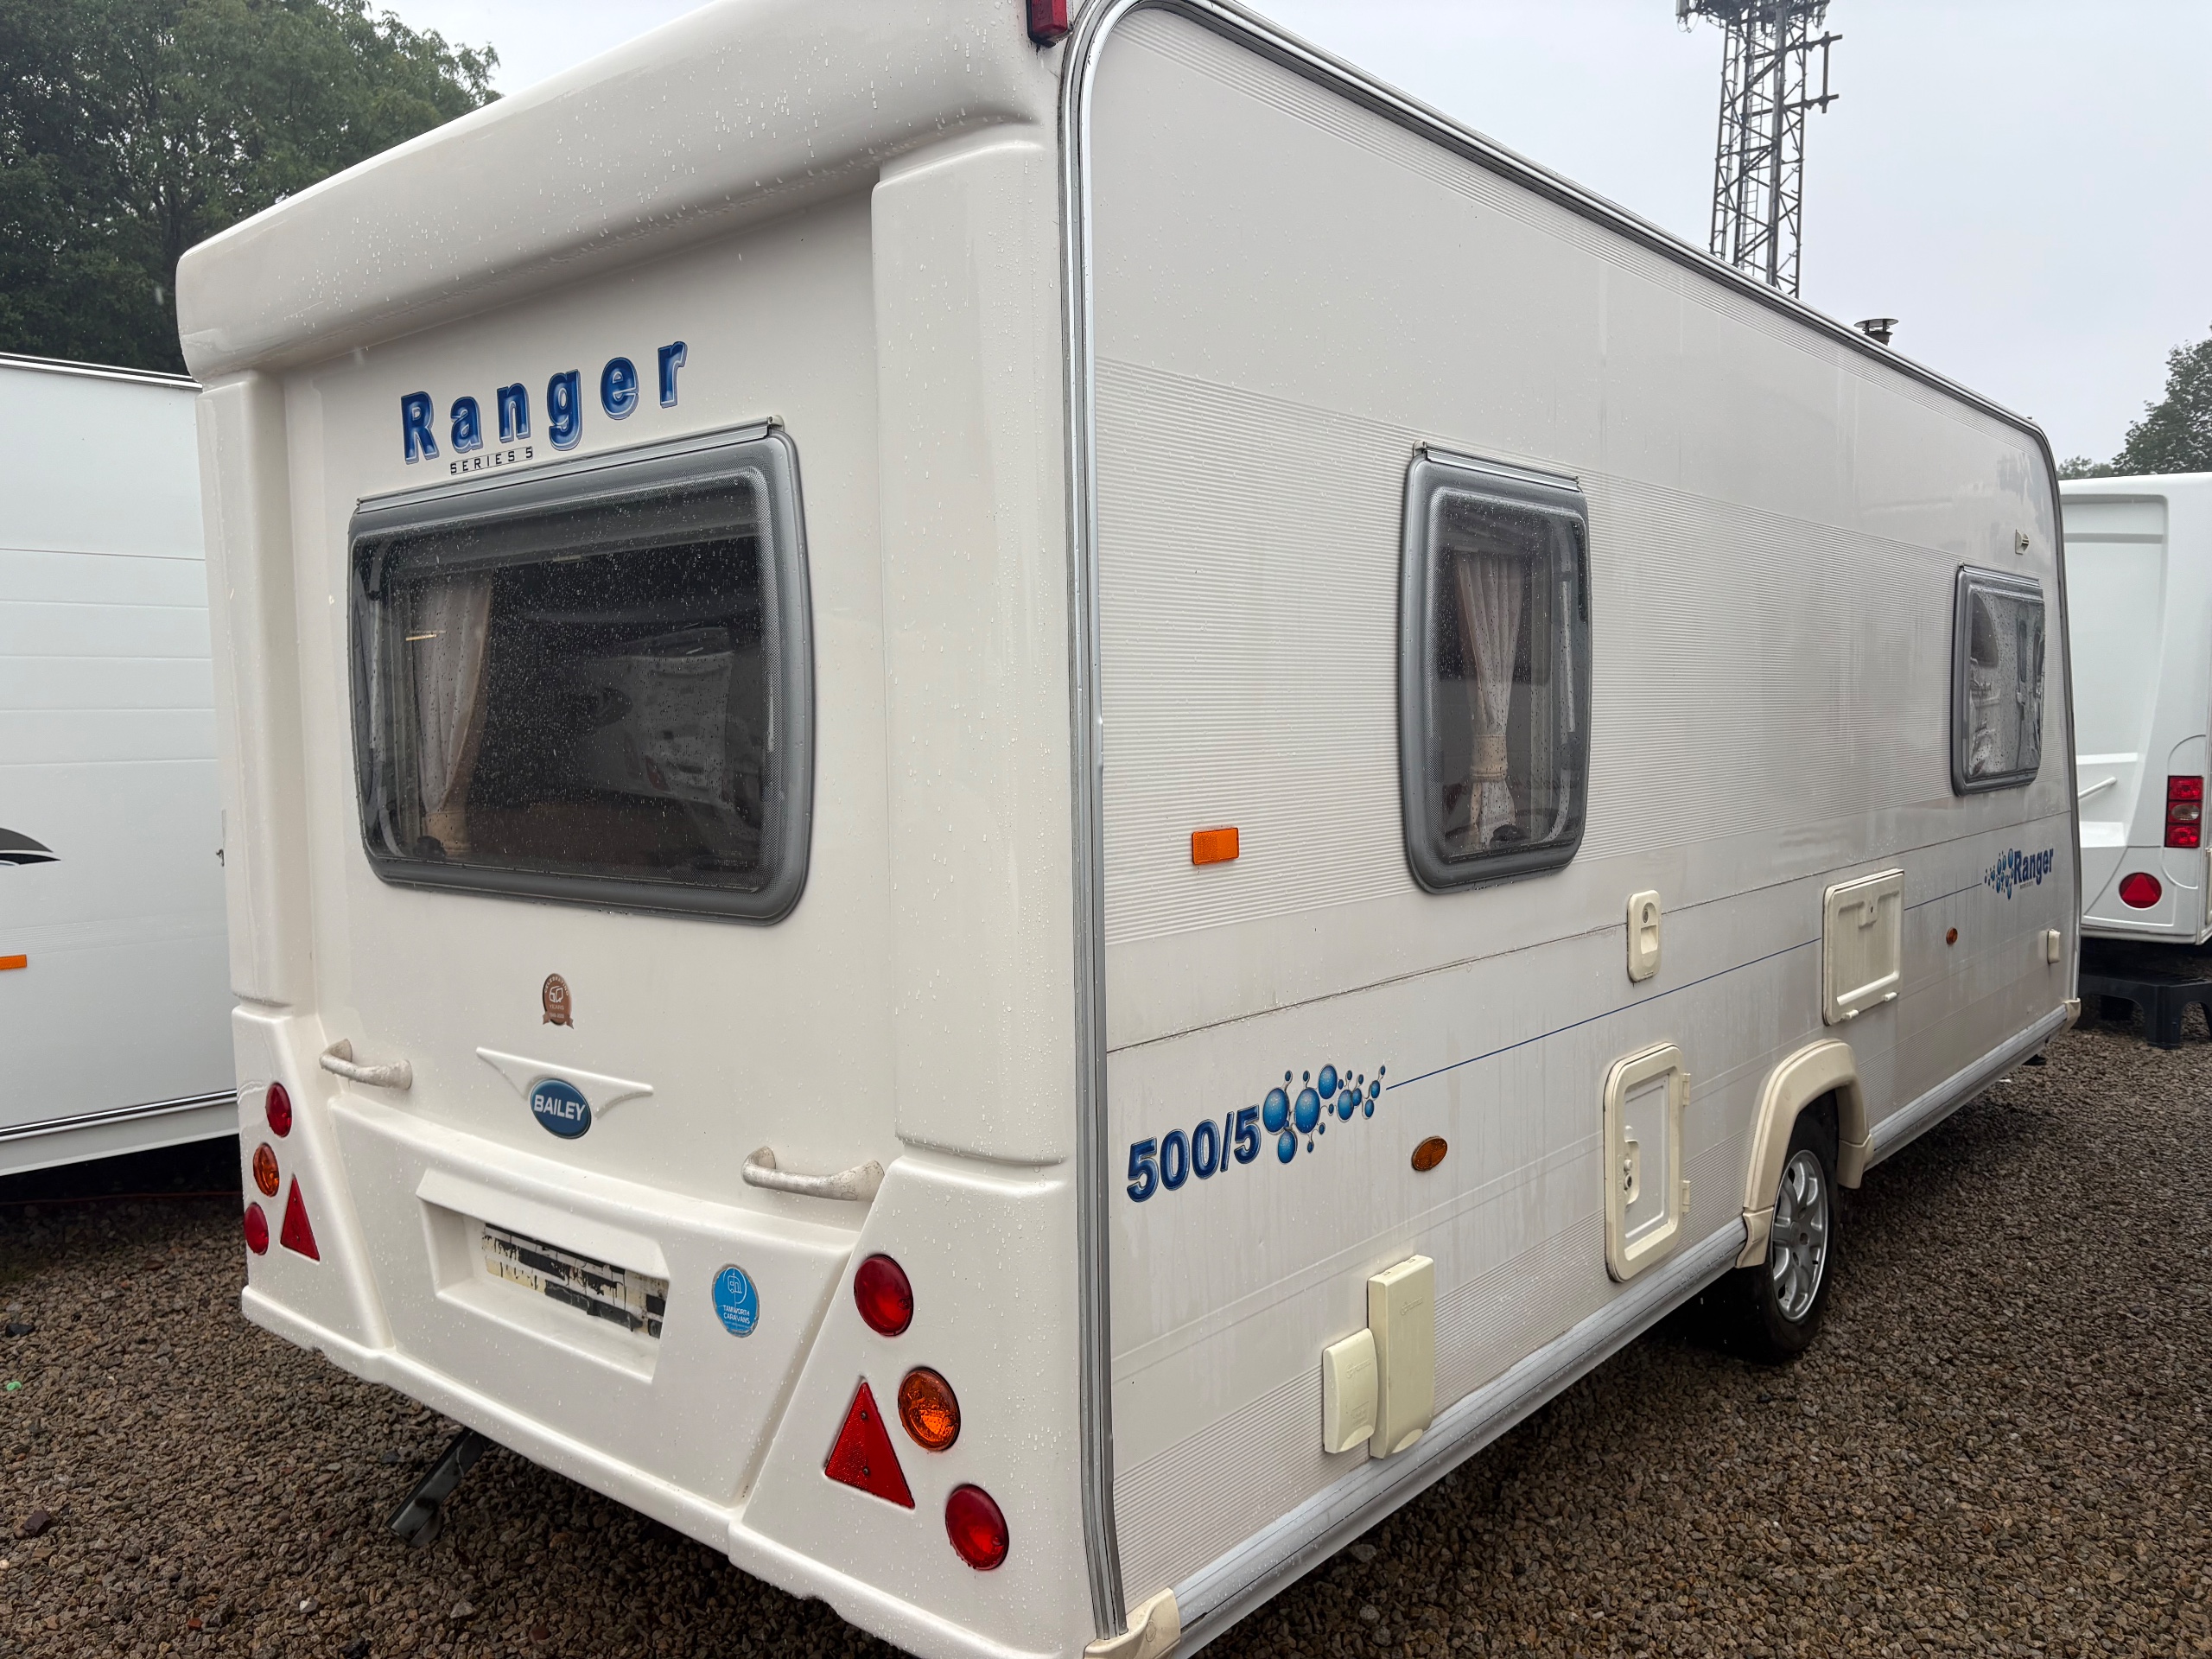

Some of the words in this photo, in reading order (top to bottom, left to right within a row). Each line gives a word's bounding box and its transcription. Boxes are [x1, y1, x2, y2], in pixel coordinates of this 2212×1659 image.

[400, 340, 688, 465] Ranger
[450, 450, 516, 474] SERIES
[525, 447, 533, 459] 5
[2013, 848, 2054, 886] Ranger
[533, 1094, 586, 1122] BAILEY
[1126, 1104, 1262, 1203] 500/5
[722, 1304, 750, 1317] TAMWORTH
[723, 1312, 751, 1325] CARAVANS
